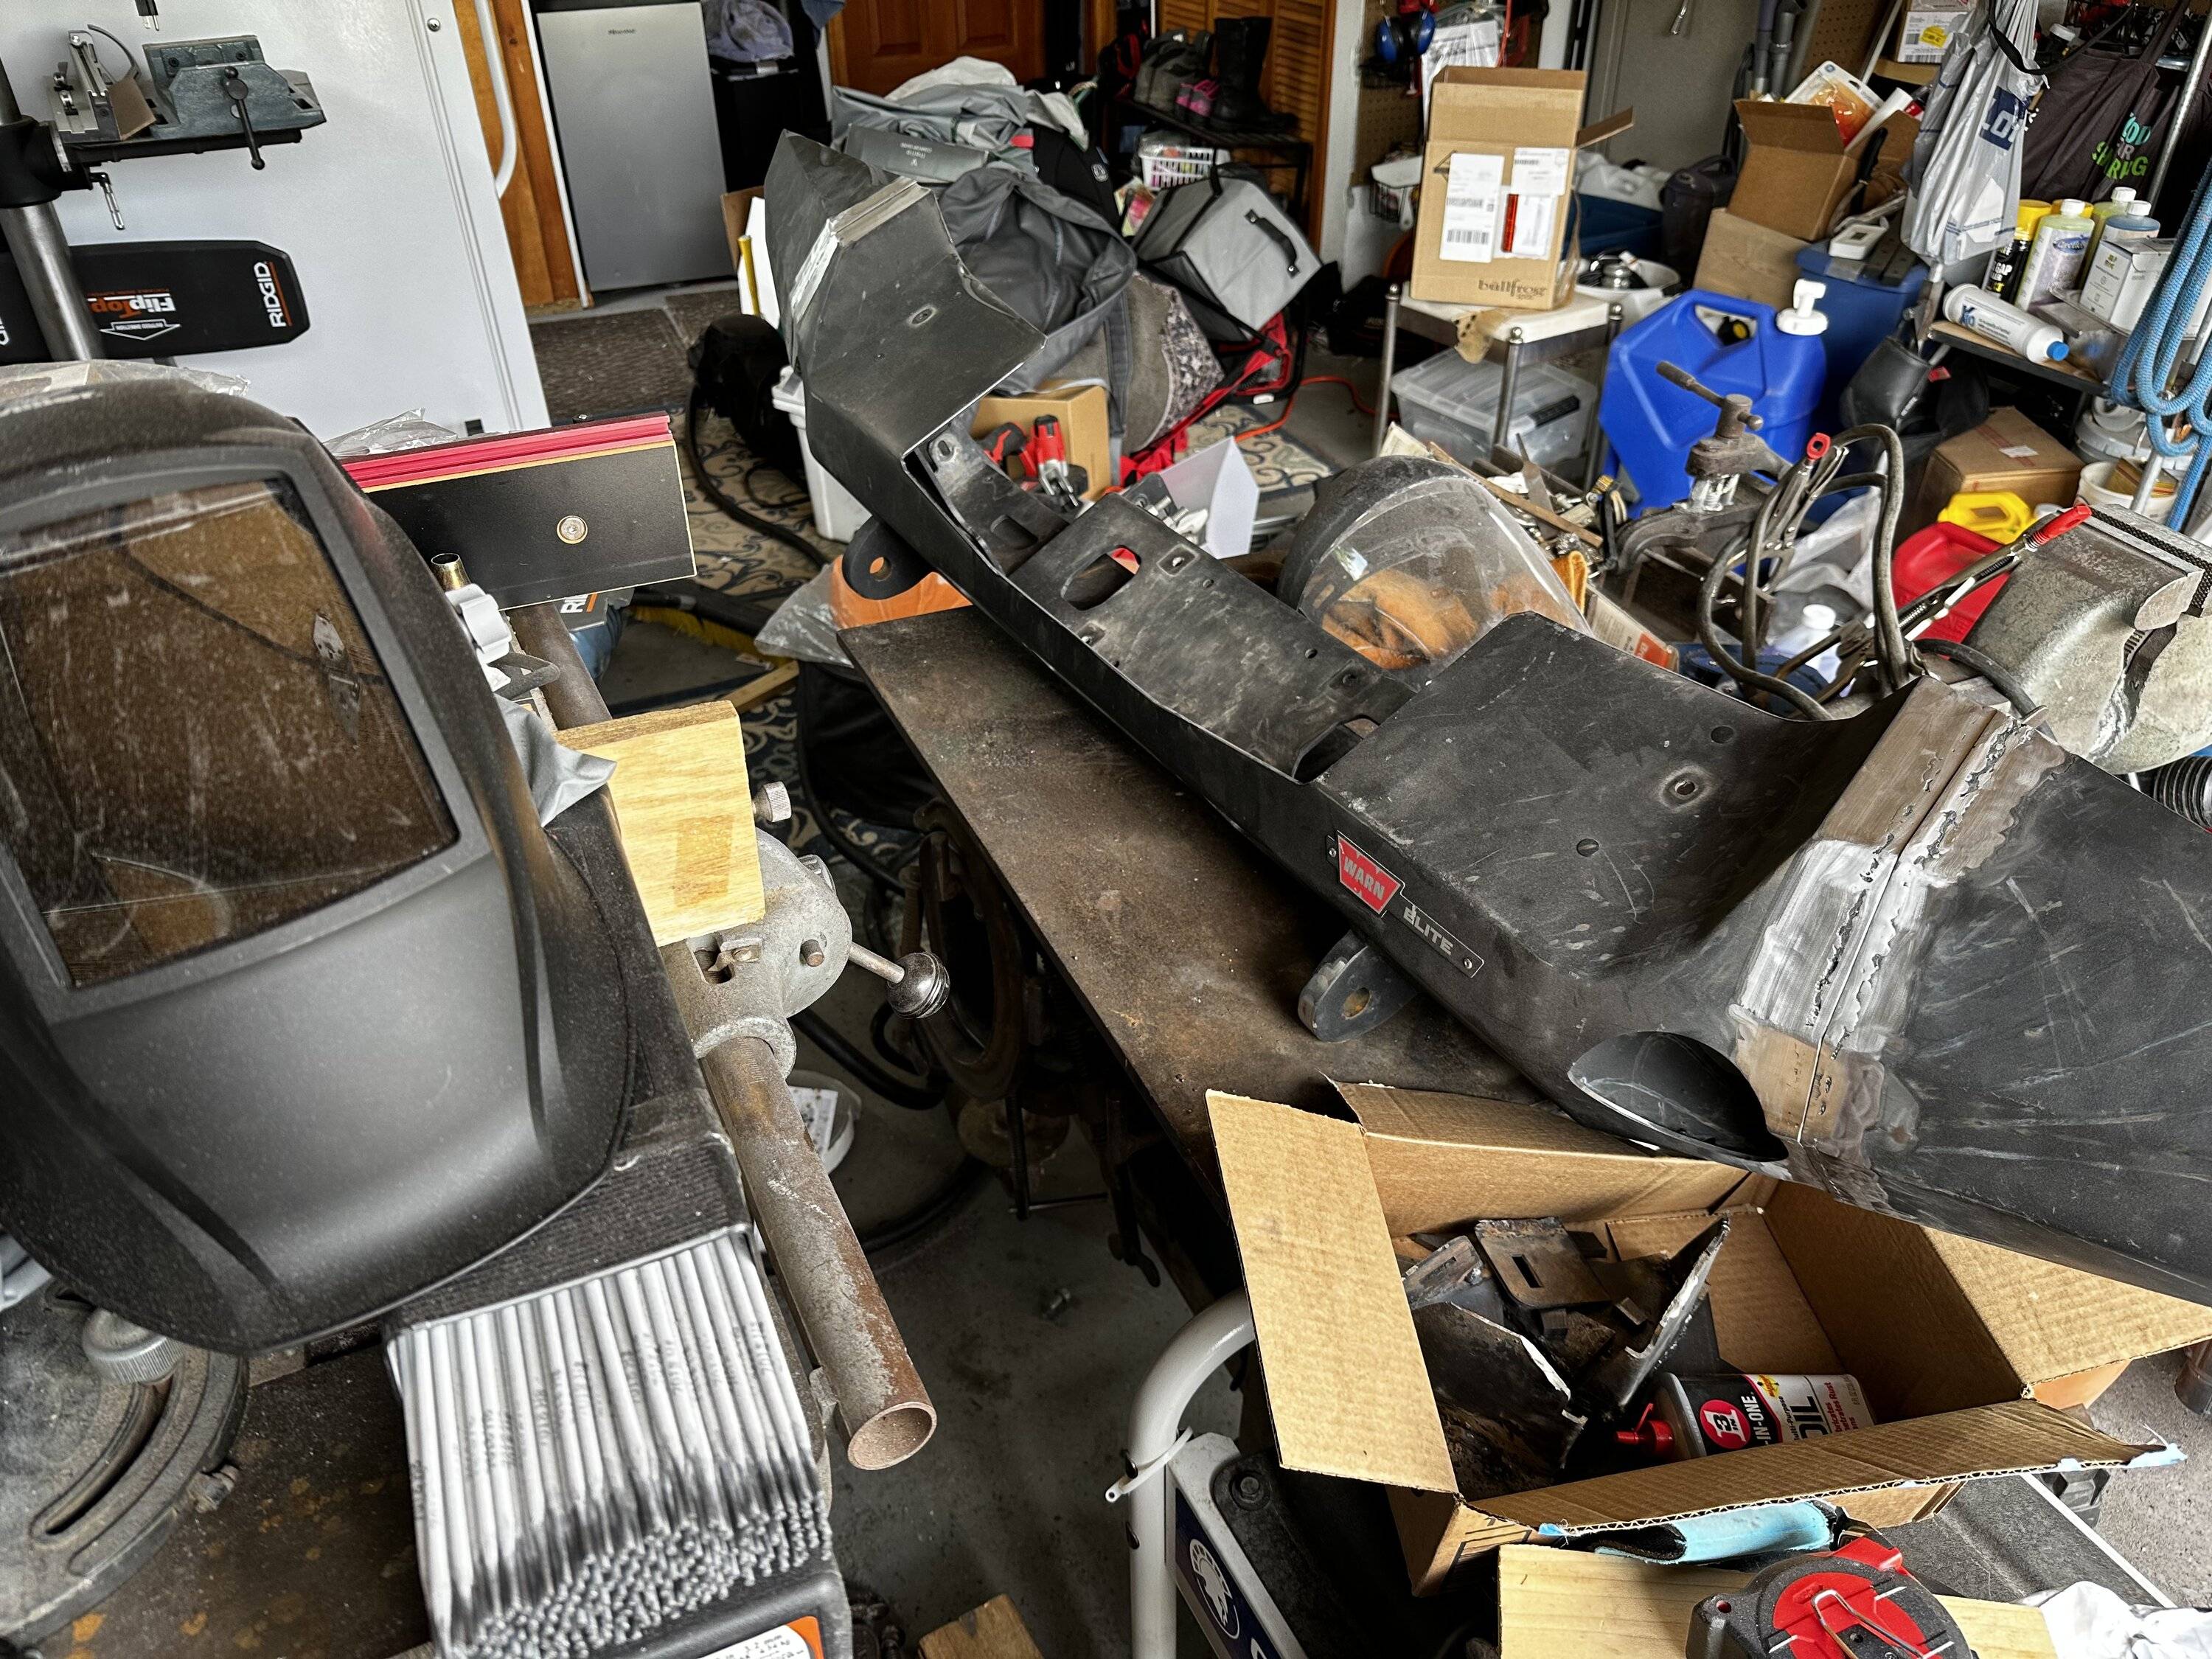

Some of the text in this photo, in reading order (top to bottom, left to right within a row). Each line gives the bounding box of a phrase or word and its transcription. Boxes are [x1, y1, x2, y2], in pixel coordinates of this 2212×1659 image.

[254, 261, 287, 327] RIDGID
[1478, 279, 1547, 296] bullfrog
[89, 294, 176, 319] FlipTop
[1343, 857, 1385, 900] WARN
[1403, 905, 1454, 956] ELITE
[1824, 1382, 1837, 1399] Rust
[1714, 1413, 1731, 1432] 3
[1731, 1419, 1739, 1430] IN
[1741, 1395, 1771, 1445] -IN-ONE
[1826, 1402, 1843, 1432] bricates
[1833, 1400, 1850, 1430] netrates
[1849, 1416, 1859, 1429] ans
